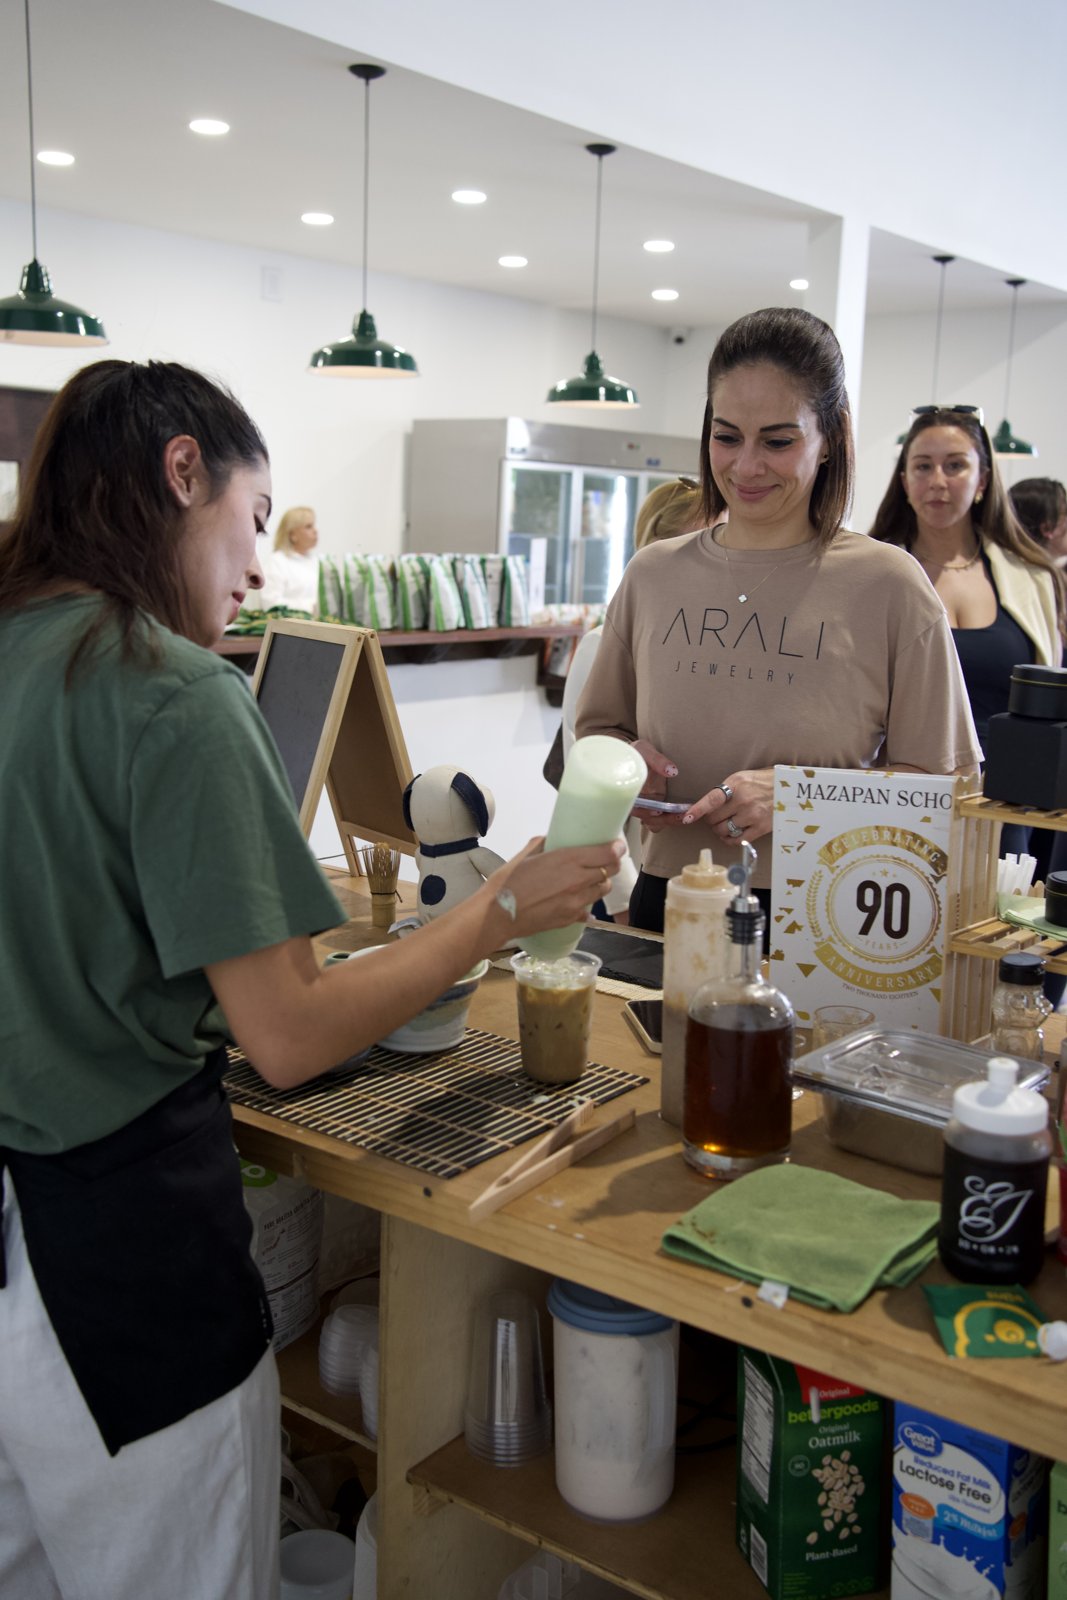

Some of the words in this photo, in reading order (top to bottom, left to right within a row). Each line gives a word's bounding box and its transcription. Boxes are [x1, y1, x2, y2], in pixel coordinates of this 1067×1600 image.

[662, 607, 825, 660] ARALI
[674, 660, 794, 685] JEWELRY
[795, 782, 891, 805] MAZAPAN
[897, 790, 953, 810] SCHO
[831, 829, 941, 862] CELEBRATING
[856, 880, 911, 940] 90
[864, 939, 899, 950] YEARS
[826, 954, 936, 988] ANNIVERSARY
[856, 989, 888, 1000] THOUSAND
[819, 1387, 850, 1399] Original
[787, 1400, 879, 1424] betergoods
[808, 1430, 861, 1449] Oatmilk
[818, 1422, 850, 1434] Original
[899, 1460, 955, 1491] Lactose
[959, 1482, 992, 1504] Free
[913, 1455, 955, 1478] Reduced
[956, 1470, 971, 1483] Fat
[972, 1477, 992, 1491] Milk
[805, 1544, 859, 1562] Plant-Based
